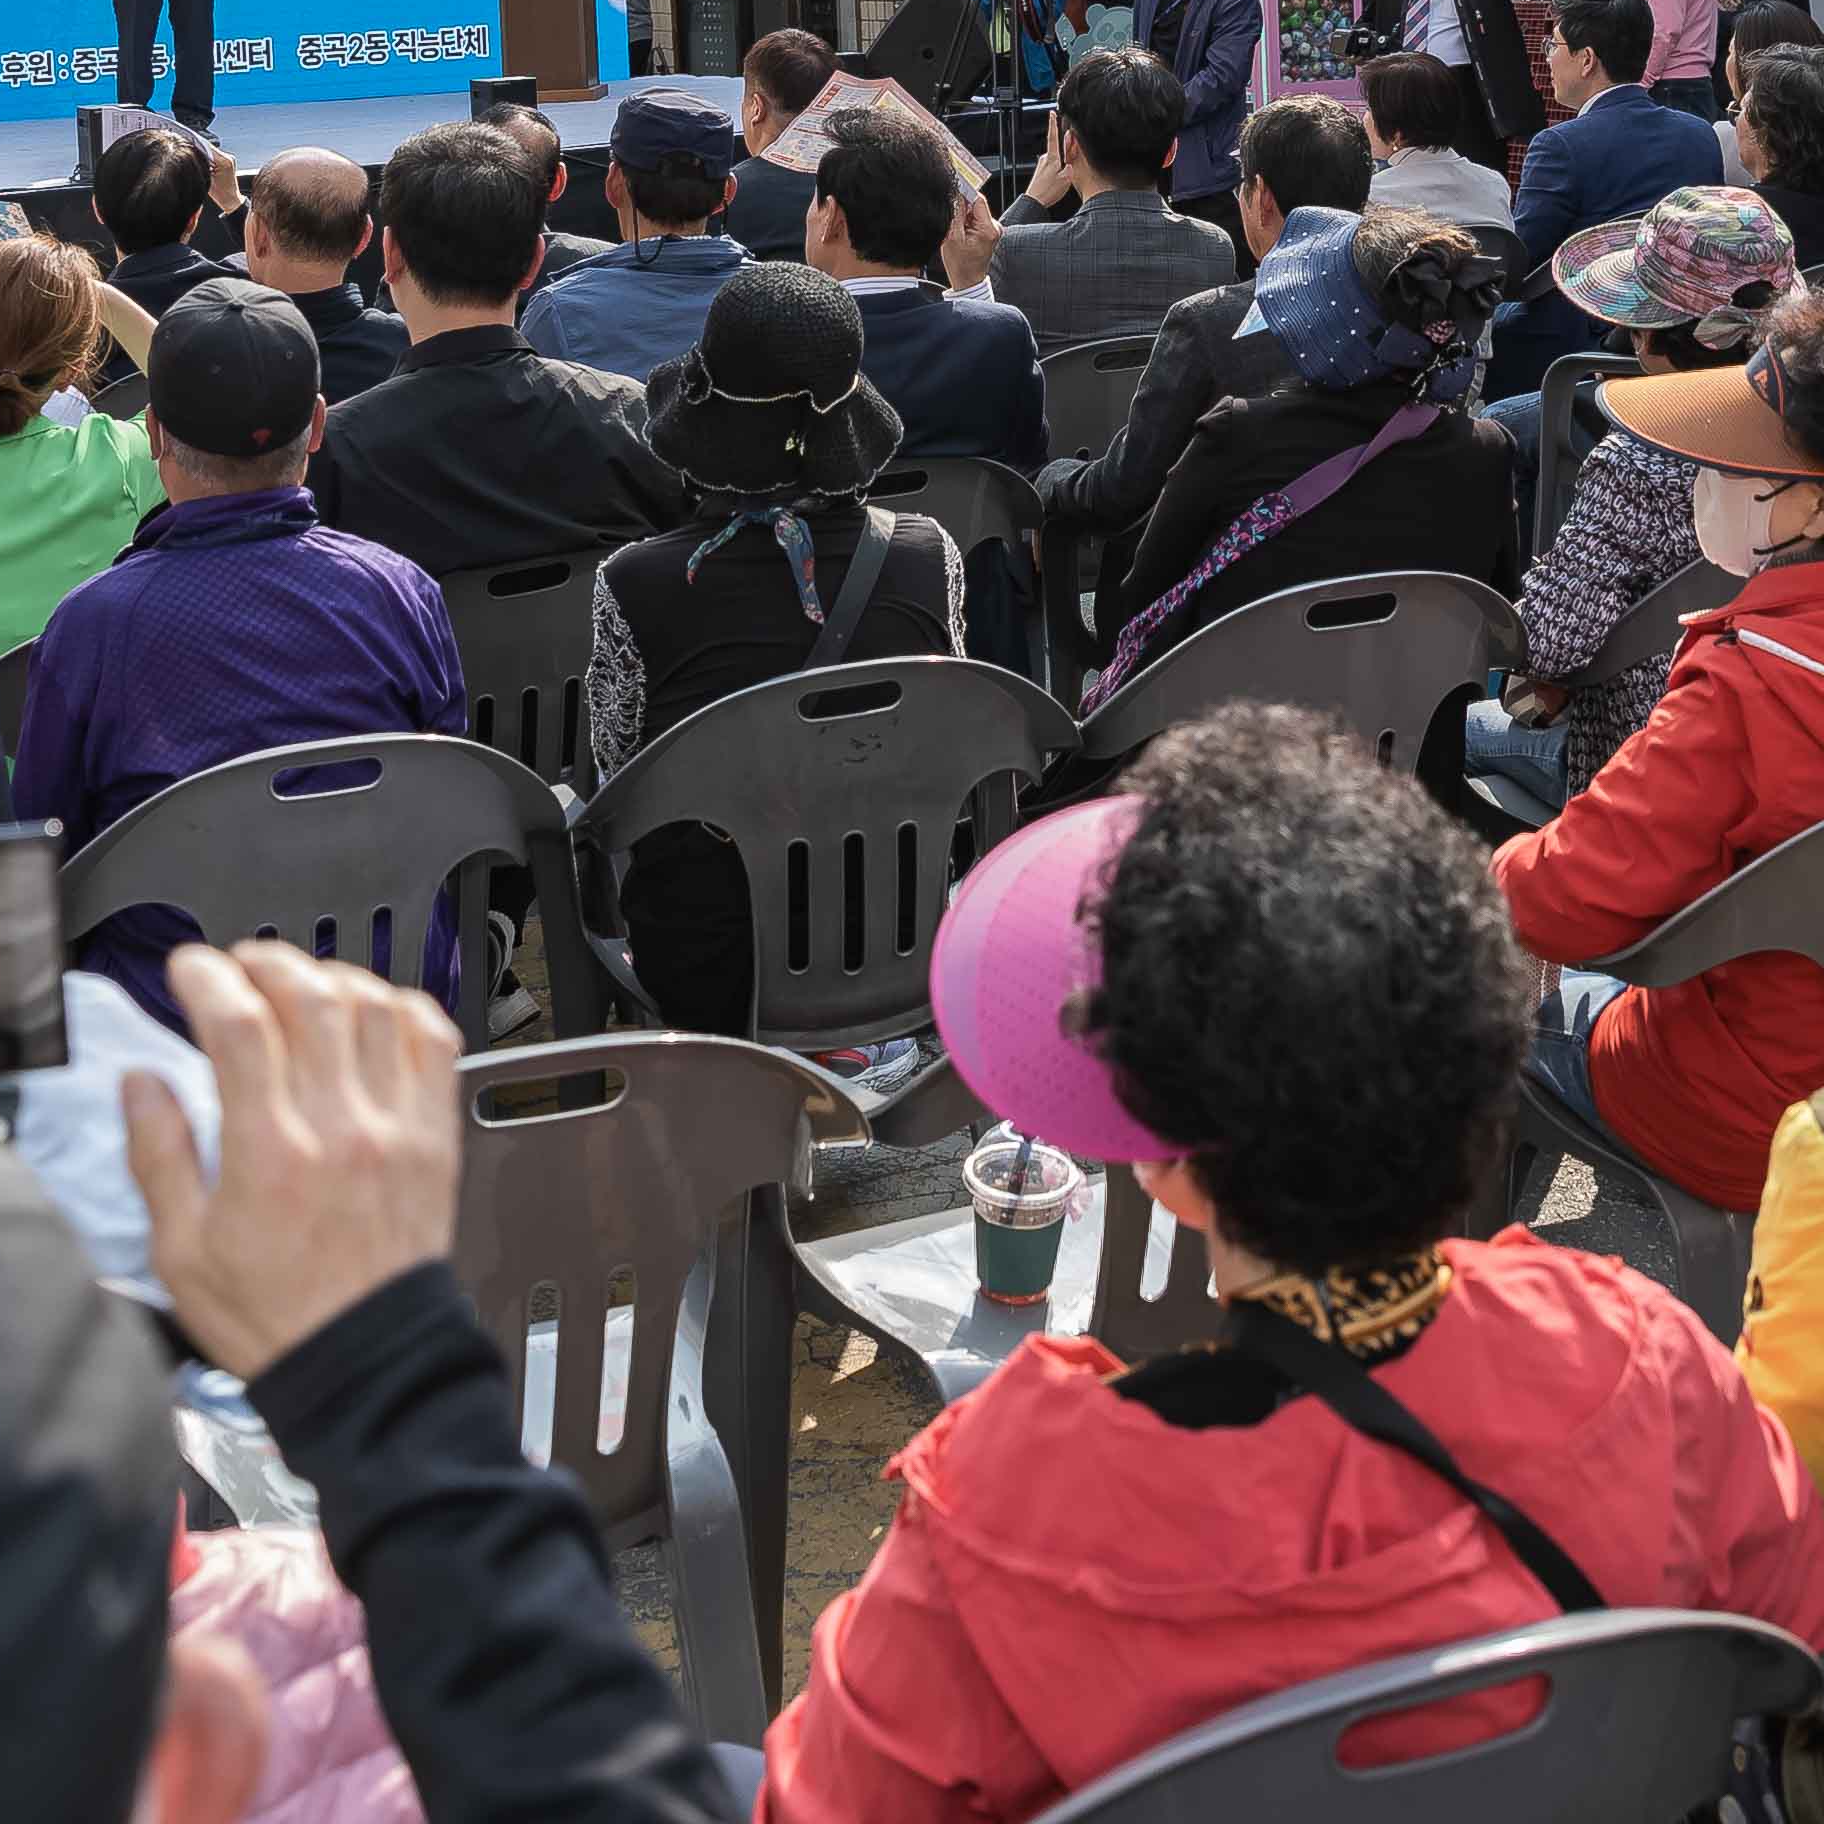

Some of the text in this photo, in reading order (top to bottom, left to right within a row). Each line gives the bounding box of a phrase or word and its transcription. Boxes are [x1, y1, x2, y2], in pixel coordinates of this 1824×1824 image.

[0, 50, 56, 88] 후원
[72, 46, 169, 85] 중곡동
[295, 29, 390, 69] 중곡2동
[393, 23, 490, 64] 직능단체
